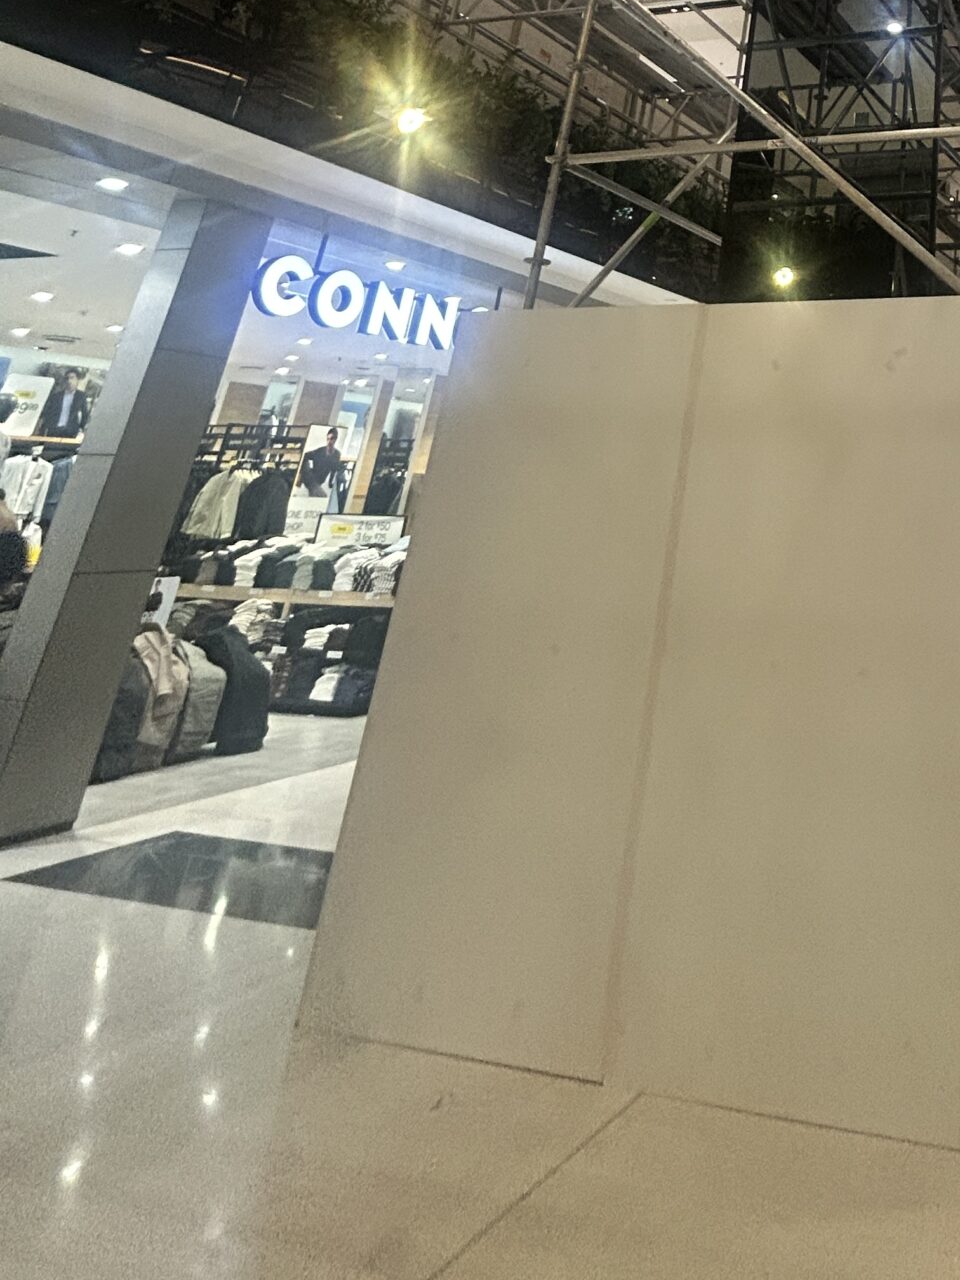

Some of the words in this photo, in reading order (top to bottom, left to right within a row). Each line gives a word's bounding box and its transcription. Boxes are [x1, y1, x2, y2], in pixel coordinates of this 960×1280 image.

[357, 521, 364, 530] 2
[365, 520, 376, 530] for
[355, 532, 362, 542] 3
[362, 532, 373, 542] for
